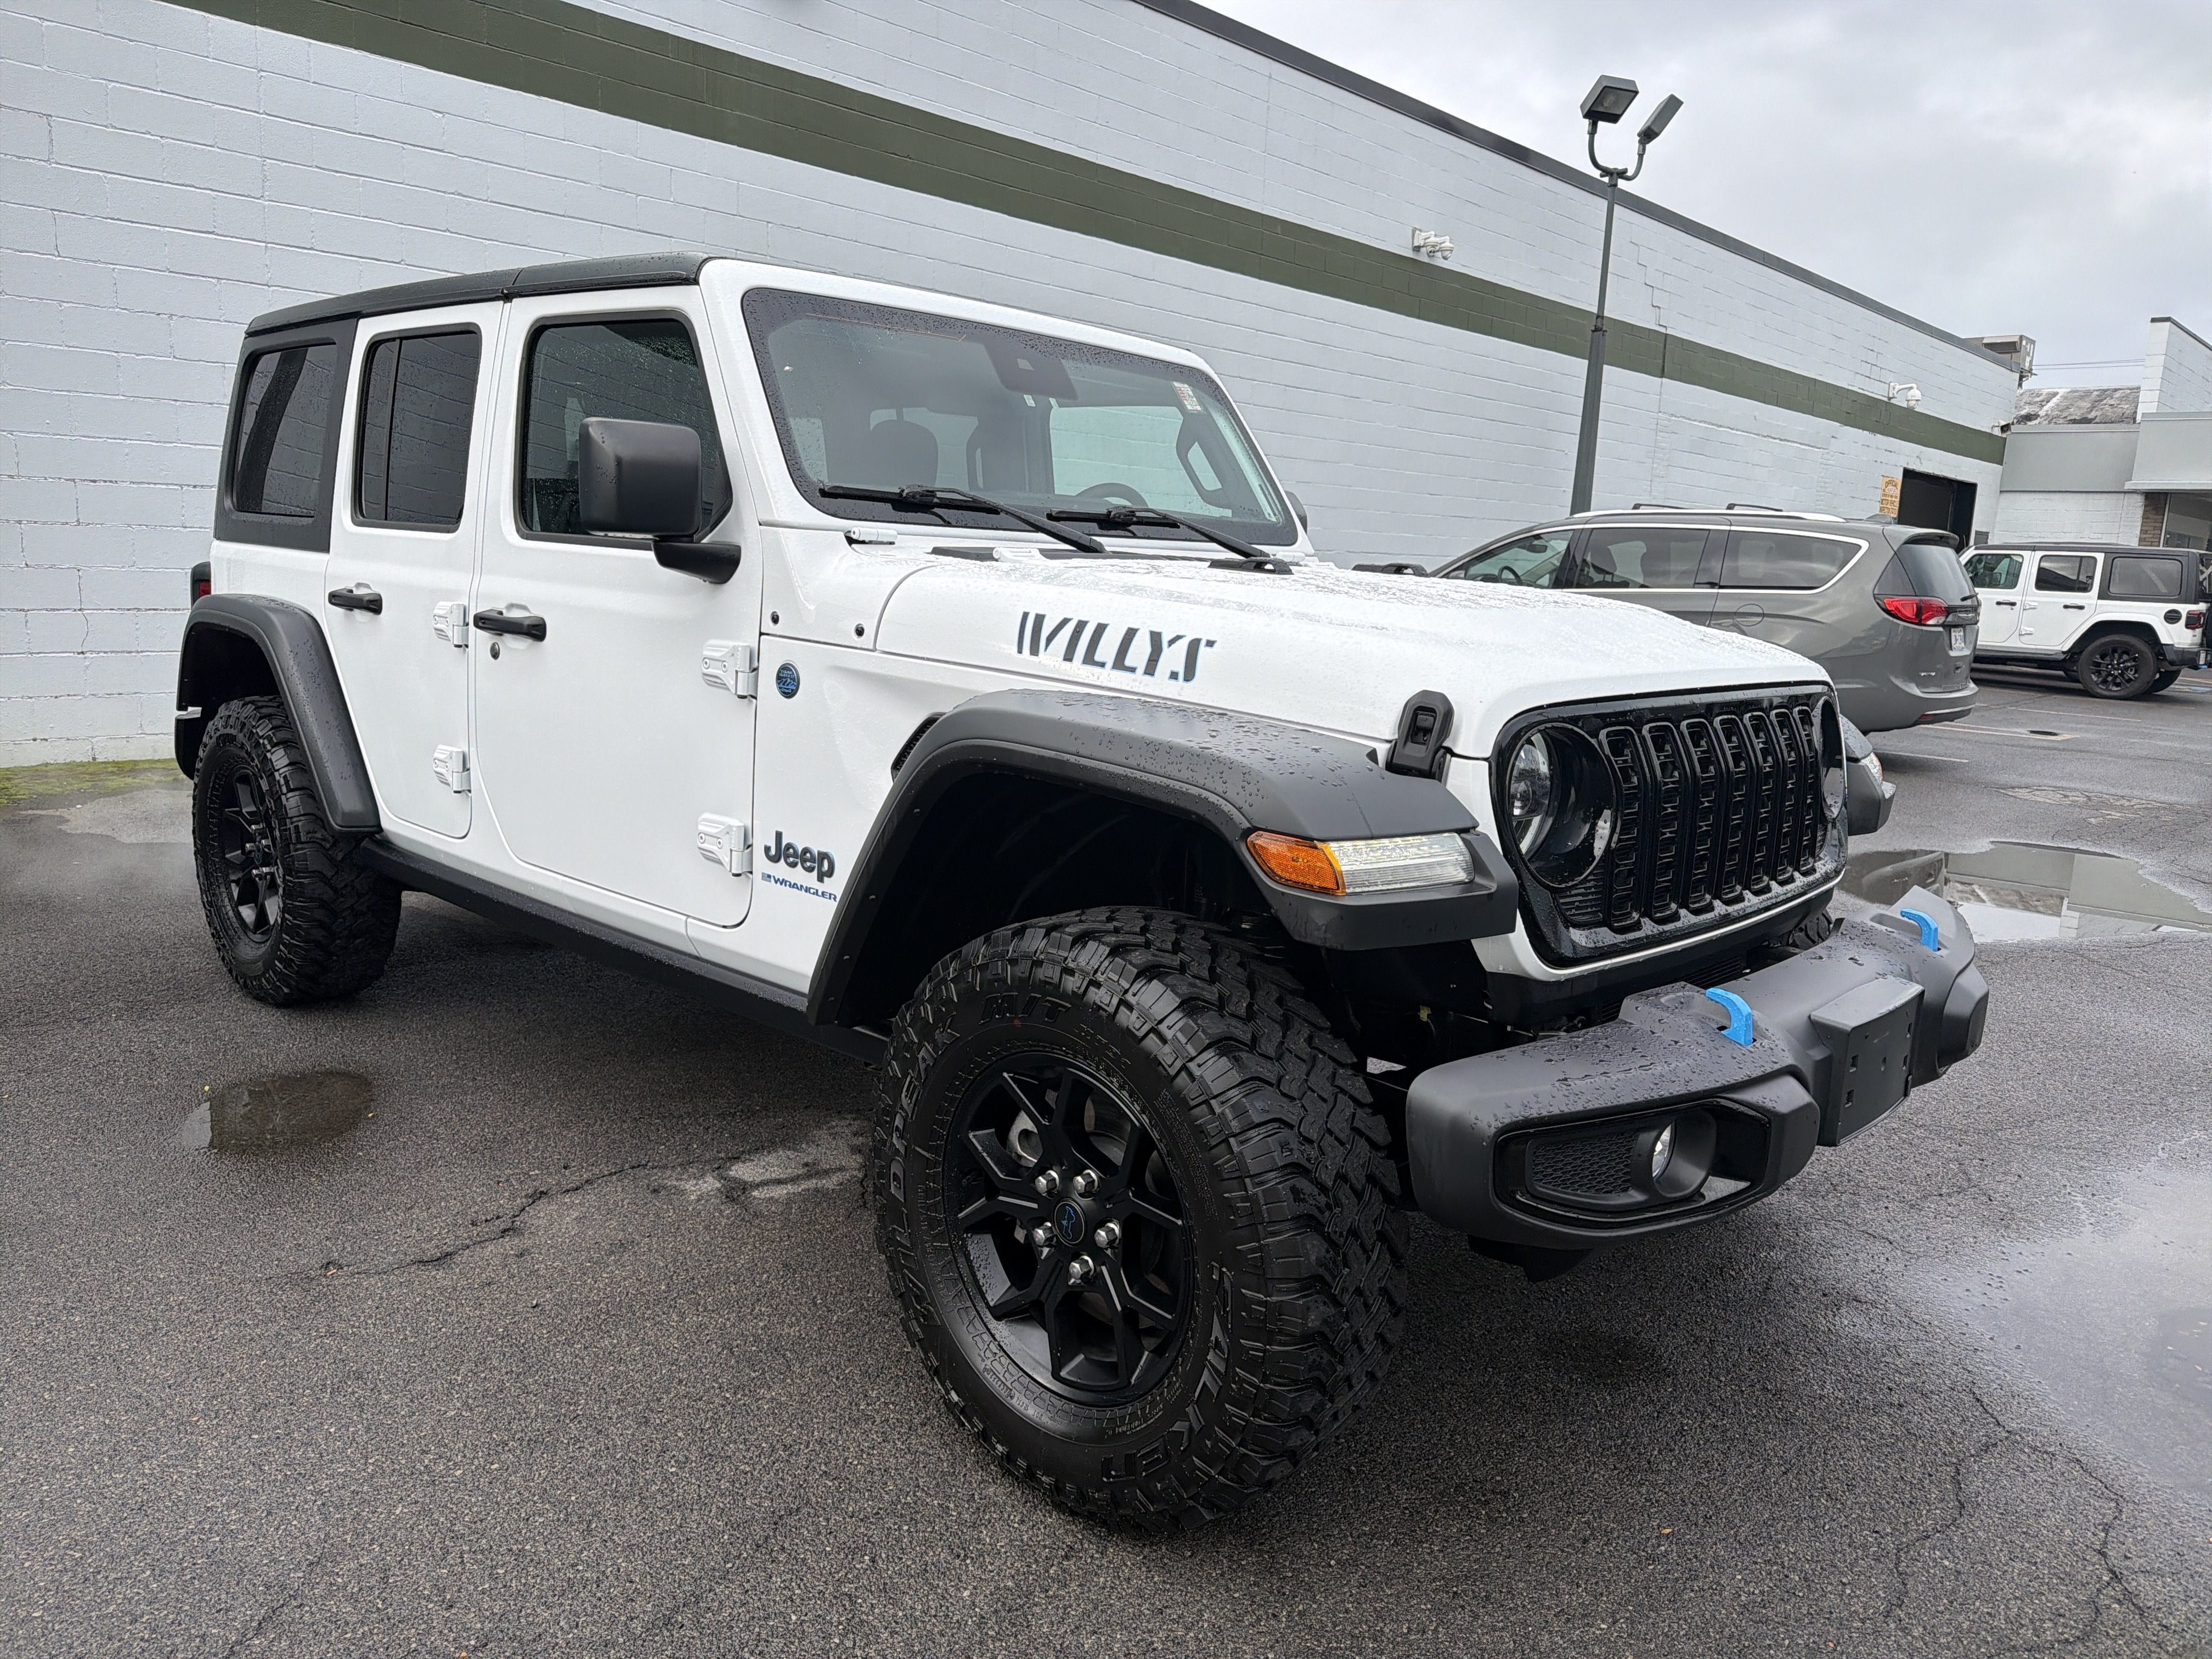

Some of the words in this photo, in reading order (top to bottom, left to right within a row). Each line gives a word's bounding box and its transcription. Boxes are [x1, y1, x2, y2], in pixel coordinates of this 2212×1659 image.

[1017, 611, 1218, 683] WILLYS
[764, 830, 835, 883] Jeep
[772, 875, 838, 902] WRANGLER
[1102, 1261, 1232, 1482] FALKEN
